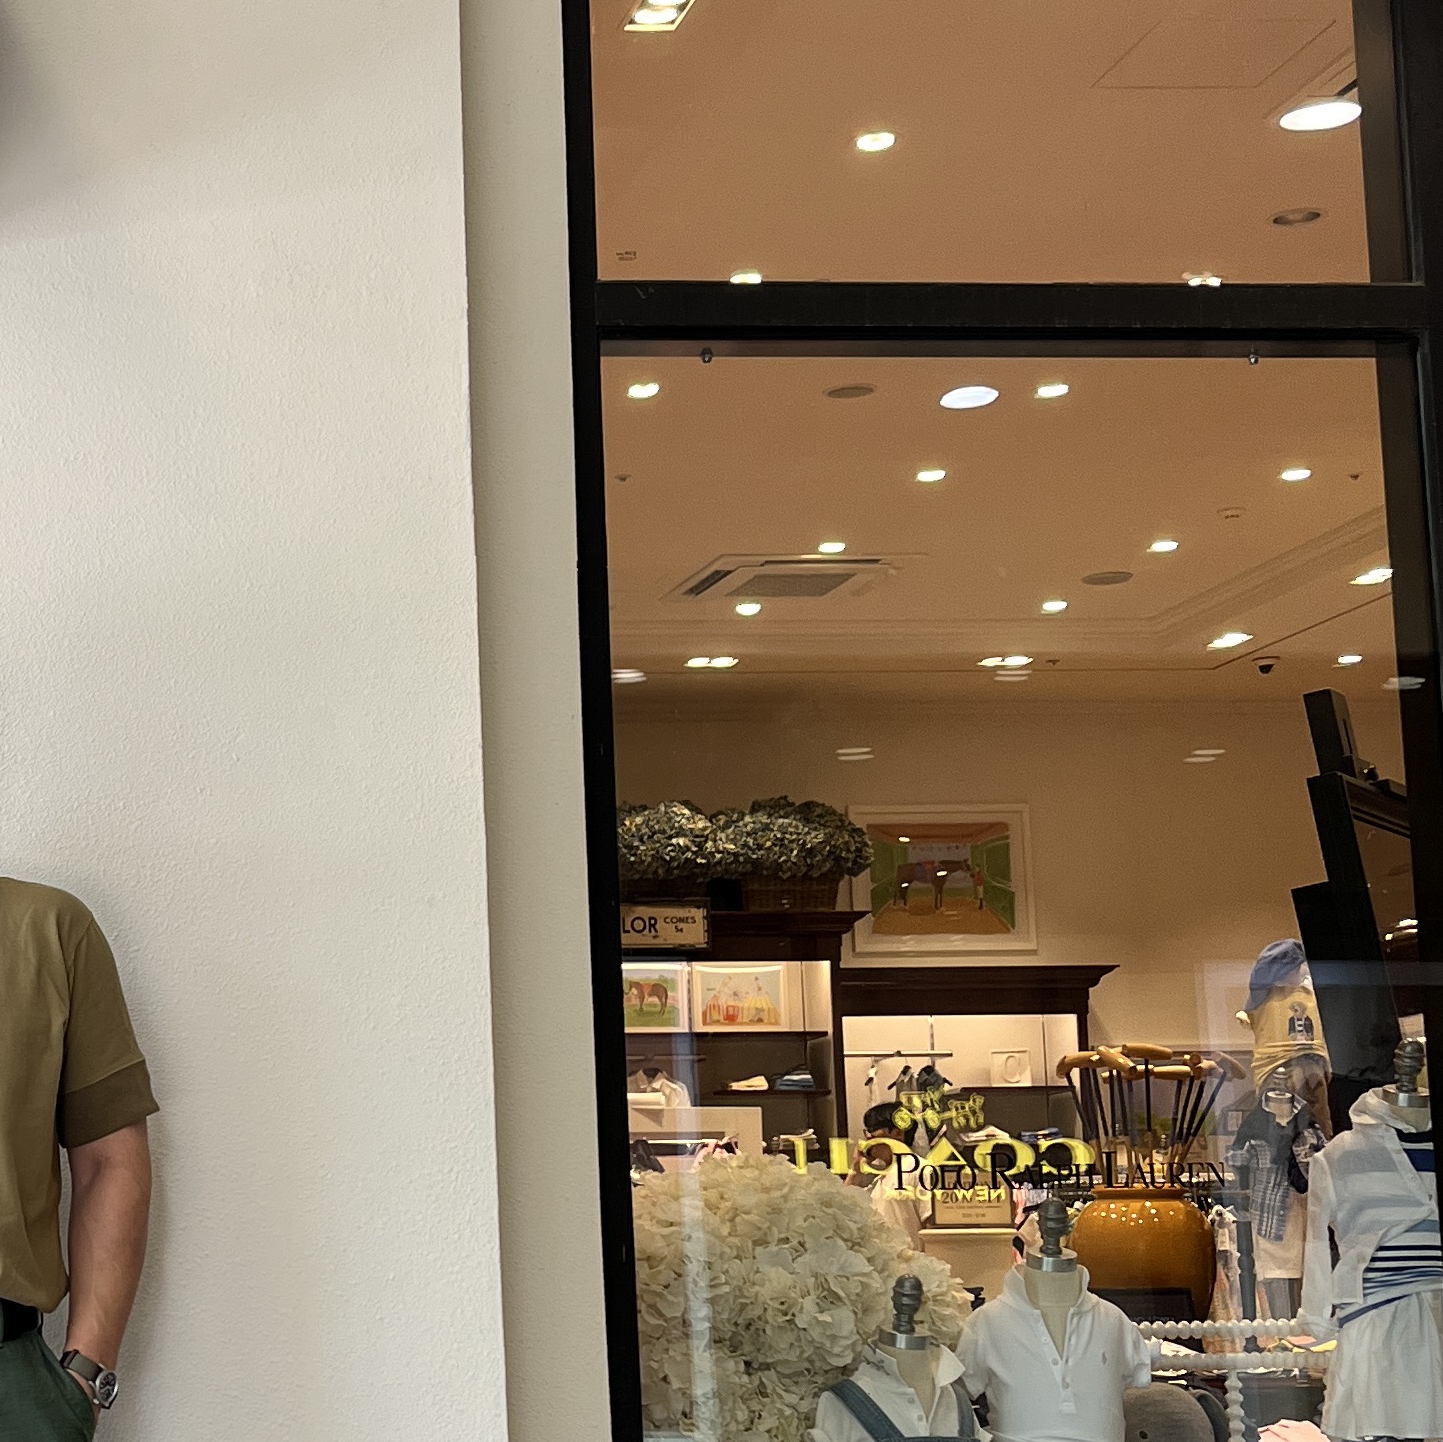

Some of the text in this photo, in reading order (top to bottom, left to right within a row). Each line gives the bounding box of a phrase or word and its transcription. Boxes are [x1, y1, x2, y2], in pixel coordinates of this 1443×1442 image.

[663, 916, 696, 924] CONES
[987, 1152, 1096, 1190] RALPH
[1102, 1151, 1225, 1188] LAUREN
